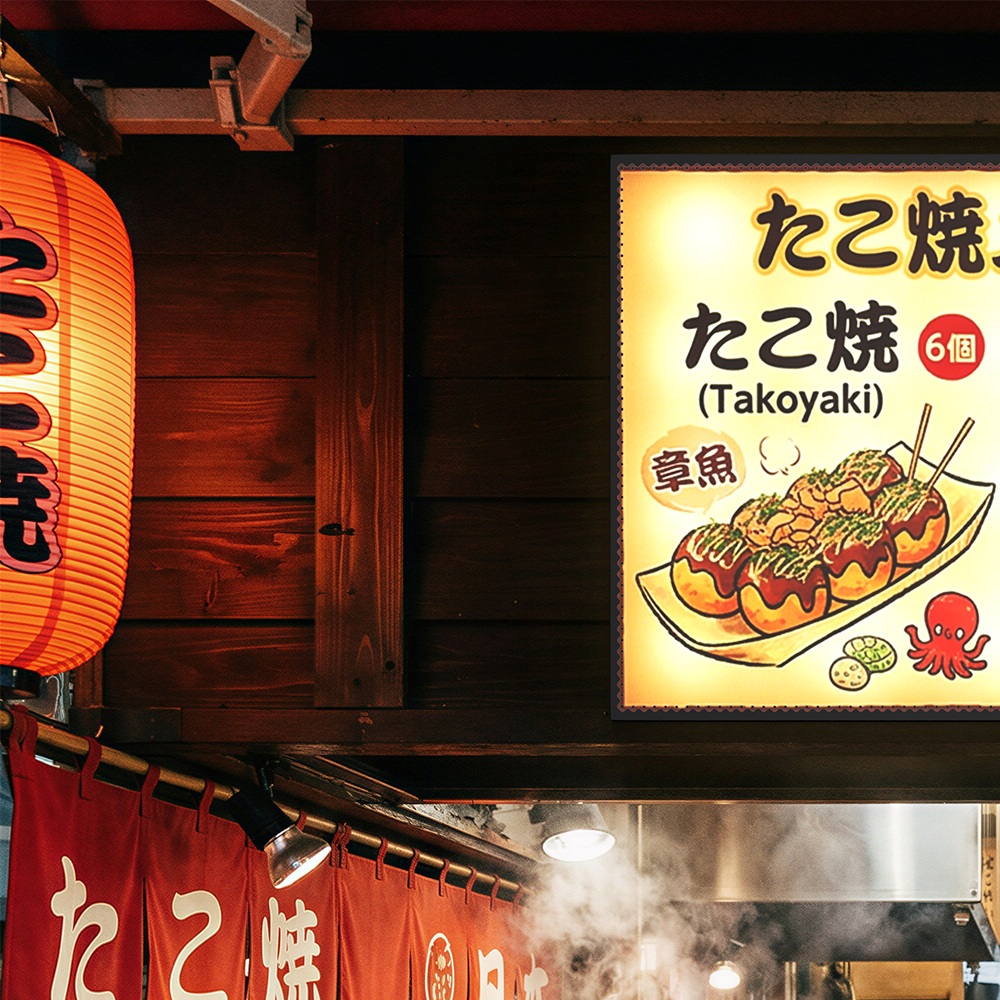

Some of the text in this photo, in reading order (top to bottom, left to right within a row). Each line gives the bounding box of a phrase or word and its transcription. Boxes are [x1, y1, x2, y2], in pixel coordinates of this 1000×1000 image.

[683, 300, 898, 373] たこ焼
[925, 333, 977, 364] 6個
[699, 383, 884, 422] (Takoyaki)
[651, 443, 738, 493] 章魚
